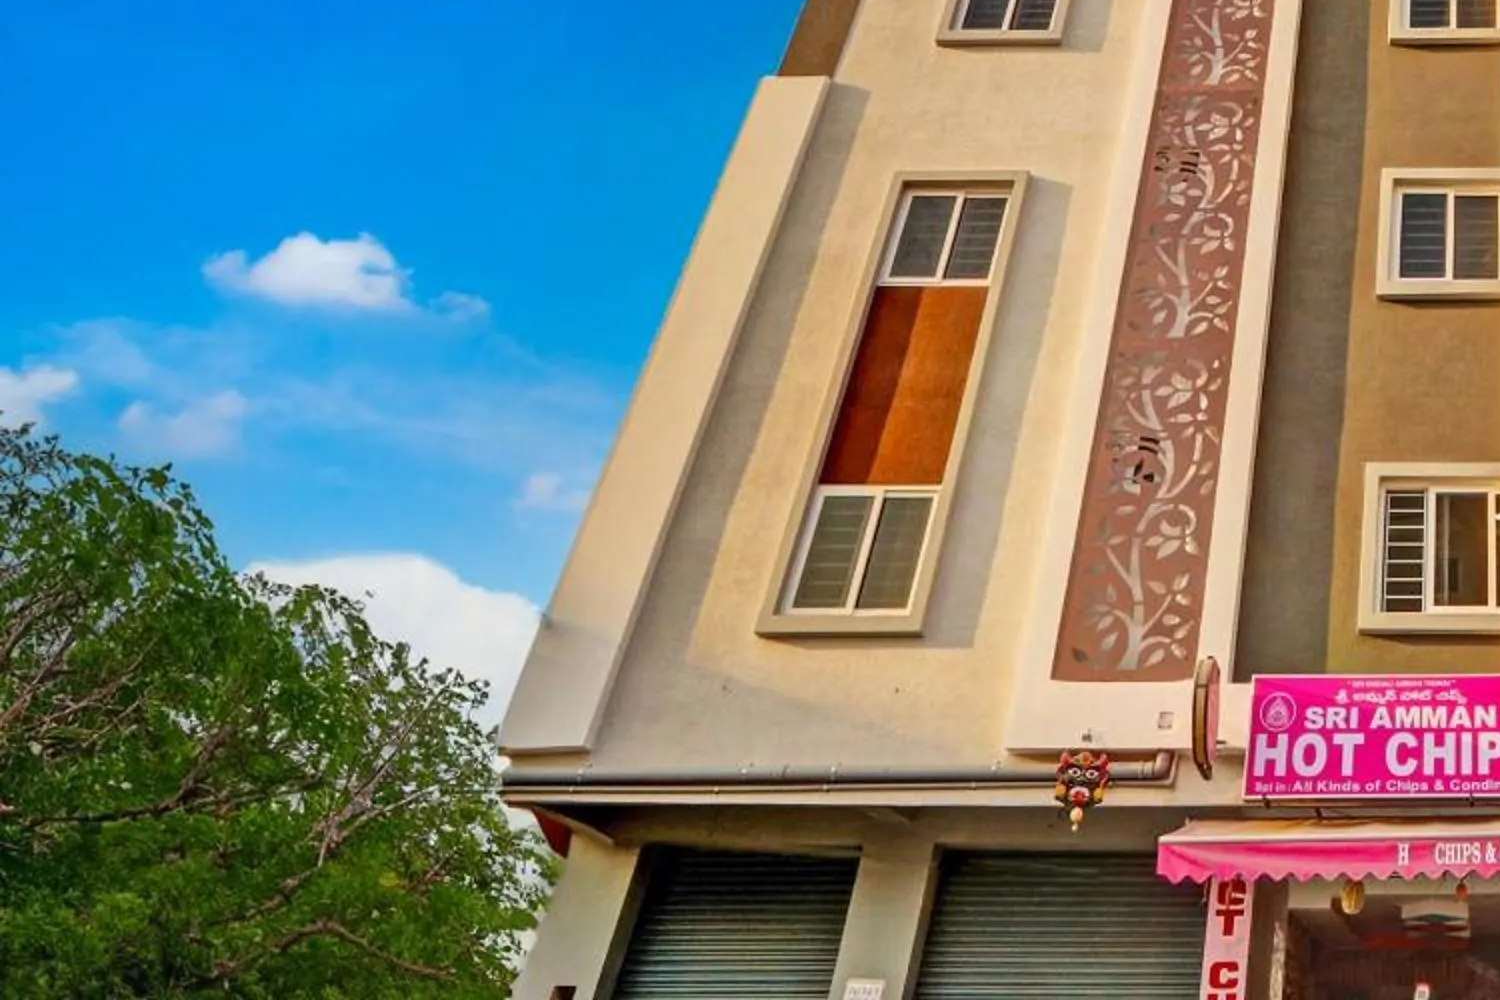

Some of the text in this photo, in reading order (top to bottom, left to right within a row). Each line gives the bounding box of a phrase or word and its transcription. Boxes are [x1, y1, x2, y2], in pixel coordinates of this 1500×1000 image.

[1303, 705, 1497, 729] SRI AMMAN
[1253, 733, 1365, 777] HOT
[1292, 780, 1314, 793] All
[1317, 779, 1360, 793] Kinds
[1365, 780, 1382, 792] of
[1385, 779, 1429, 795] Chips
[1434, 780, 1445, 791] &
[1435, 843, 1481, 865] CHIPS
[1485, 844, 1497, 864] &
[1208, 962, 1239, 1000] C
